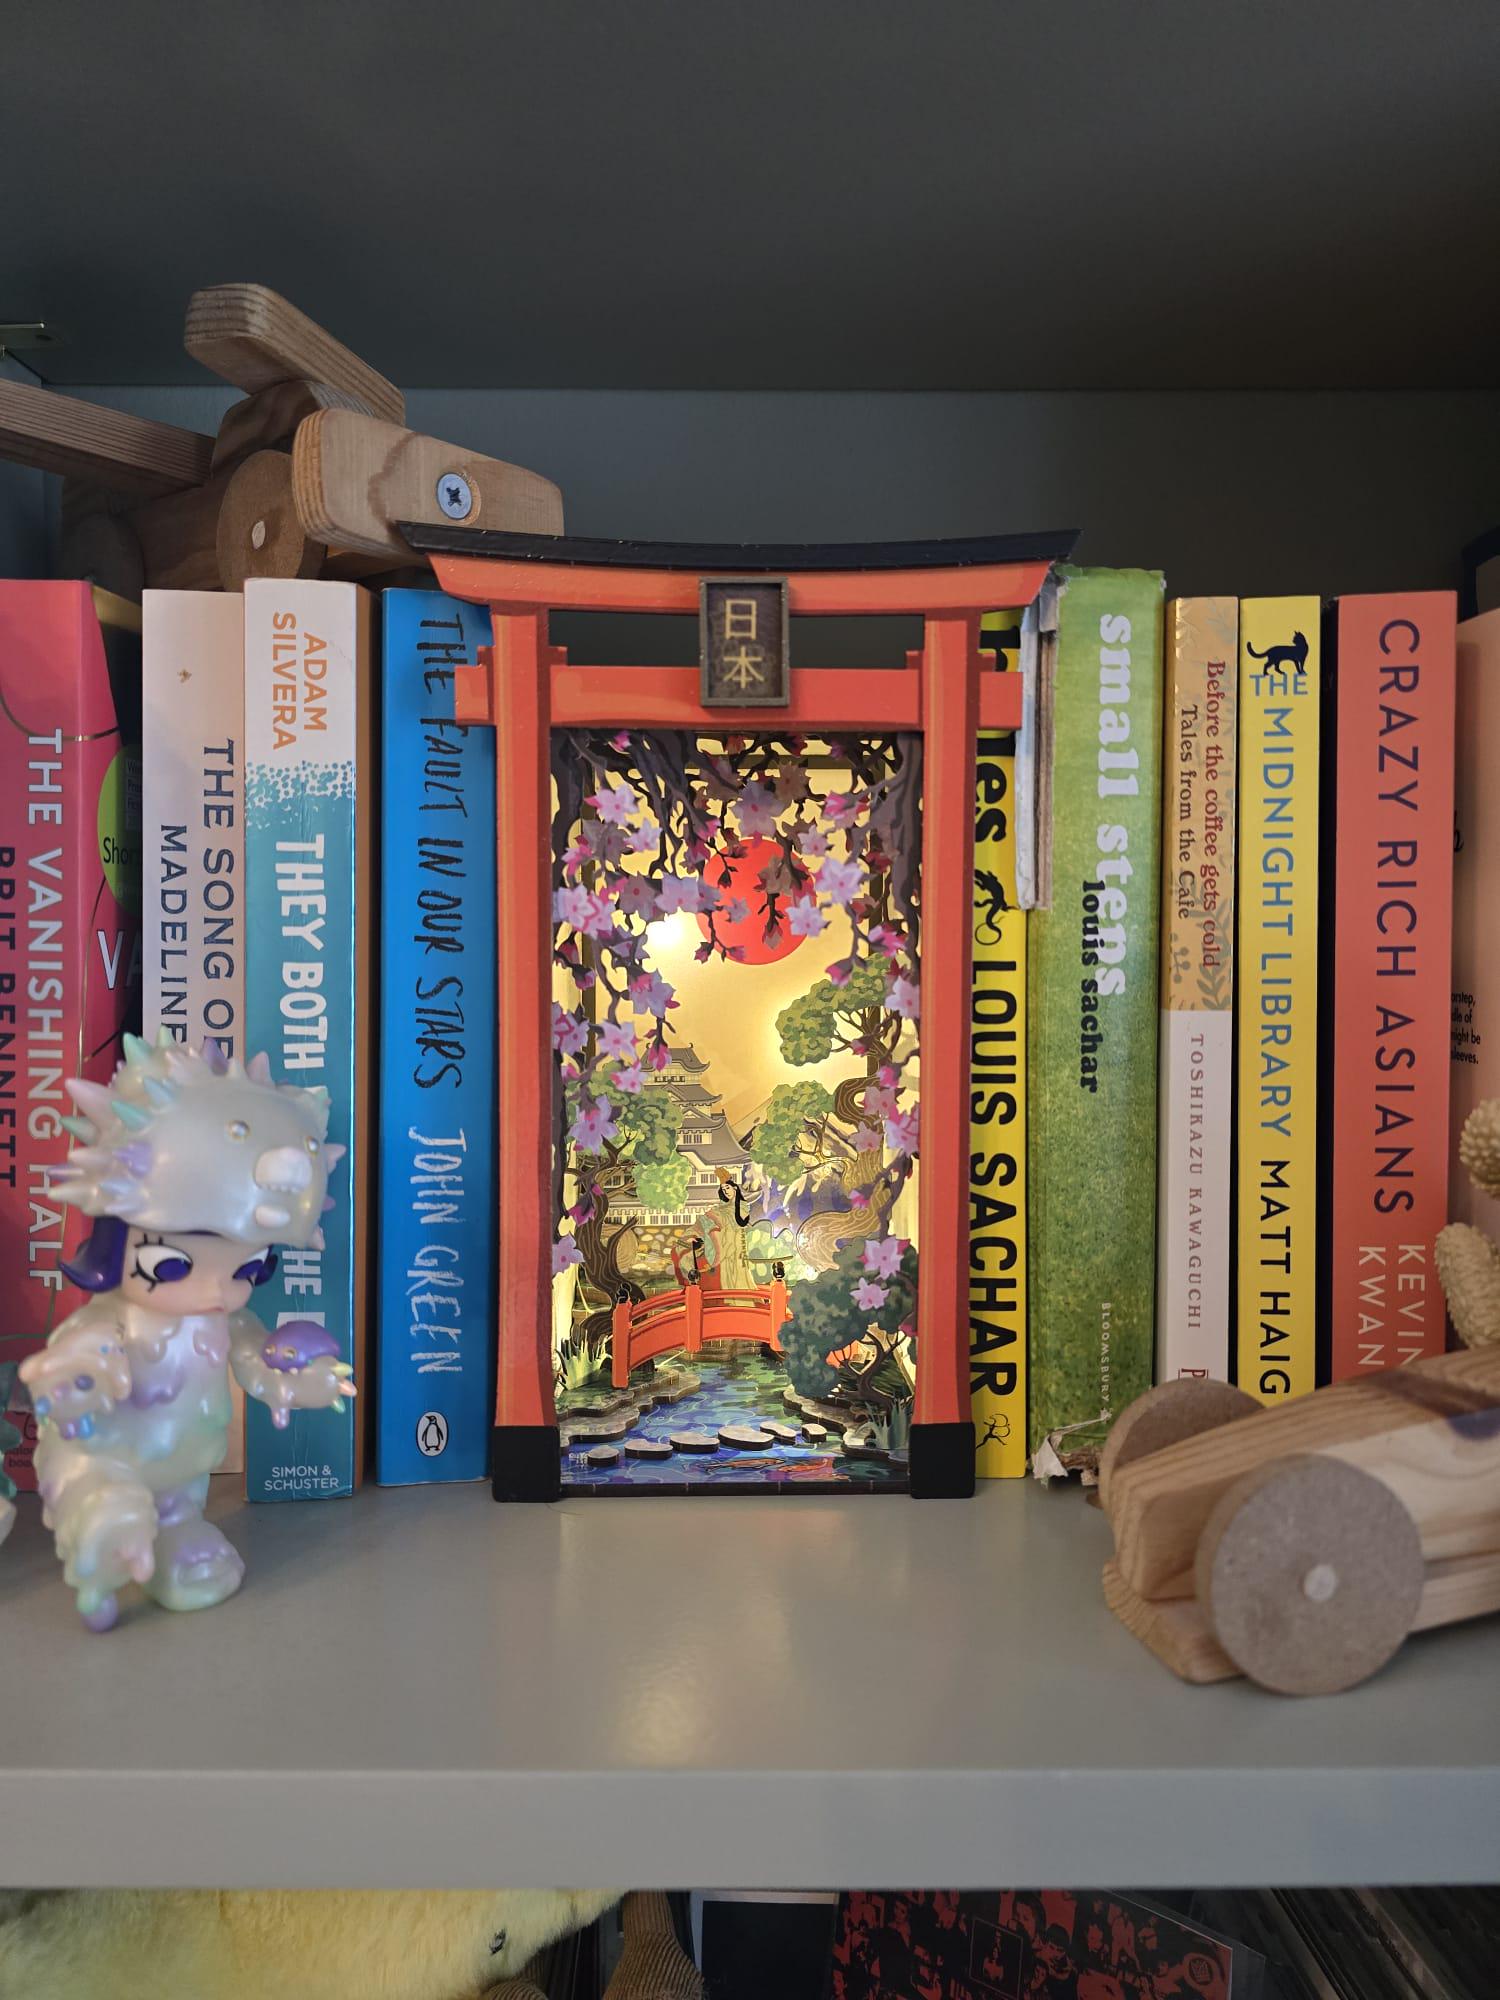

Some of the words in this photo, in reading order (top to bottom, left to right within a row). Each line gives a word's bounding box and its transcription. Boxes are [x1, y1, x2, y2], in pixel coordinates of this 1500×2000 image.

[272, 611, 297, 750] SILVERA
[303, 632, 328, 731] ADAM
[416, 612, 468, 695] THE
[723, 599, 764, 688] 日本
[1249, 673, 1308, 697] THE
[974, 626, 1021, 842] hles
[1097, 613, 1139, 798] small
[1180, 704, 1198, 763] Tales
[1205, 660, 1226, 737] Before
[1378, 619, 1420, 811] CRAZY
[27, 728, 63, 825] THE
[203, 737, 234, 829] THE
[420, 717, 468, 819] FAULT
[1179, 770, 1197, 821] from
[1205, 744, 1223, 782] the
[418, 838, 466, 878] IN
[1179, 828, 1196, 863] the
[1204, 788, 1224, 857] coffee
[1261, 708, 1295, 936] MIDNIGHT
[203, 847, 235, 980] SONG
[275, 833, 327, 951] THEY
[414, 890, 465, 954] OUR
[1081, 879, 1106, 967] louis
[1094, 823, 1133, 997] steps
[1200, 864, 1220, 913] gets
[1375, 839, 1418, 976] RICH
[27, 847, 64, 1140] VANISHING
[1202, 919, 1220, 967] cold
[279, 962, 328, 1070] BOTH
[413, 976, 466, 1089] STARS
[970, 960, 1018, 1126] LOUIS
[1079, 978, 1104, 1093] sachar
[1260, 953, 1293, 1138] LIBRARY
[1189, 1033, 1204, 1175] TOSHIKAZU
[1373, 1004, 1416, 1214] ASIANS
[28, 1163, 63, 1292] HALF
[407, 1125, 468, 1224] JOHN
[1260, 1160, 1292, 1275] MATT
[281, 1250, 322, 1296] HE
[406, 1244, 465, 1374] GREEN
[969, 1152, 1018, 1397] SACHAR
[1187, 1187, 1203, 1328] KAWAGUCHI
[1358, 1246, 1386, 1366] KWAN
[1397, 1244, 1426, 1365] KEVIN
[1100, 1302, 1111, 1402] BLOOMSBURY
[1259, 1291, 1292, 1396] HAIG
[264, 1477, 340, 1492] SCHUSTER
[271, 1465, 313, 1478] SIMON
[316, 1464, 332, 1476] &
